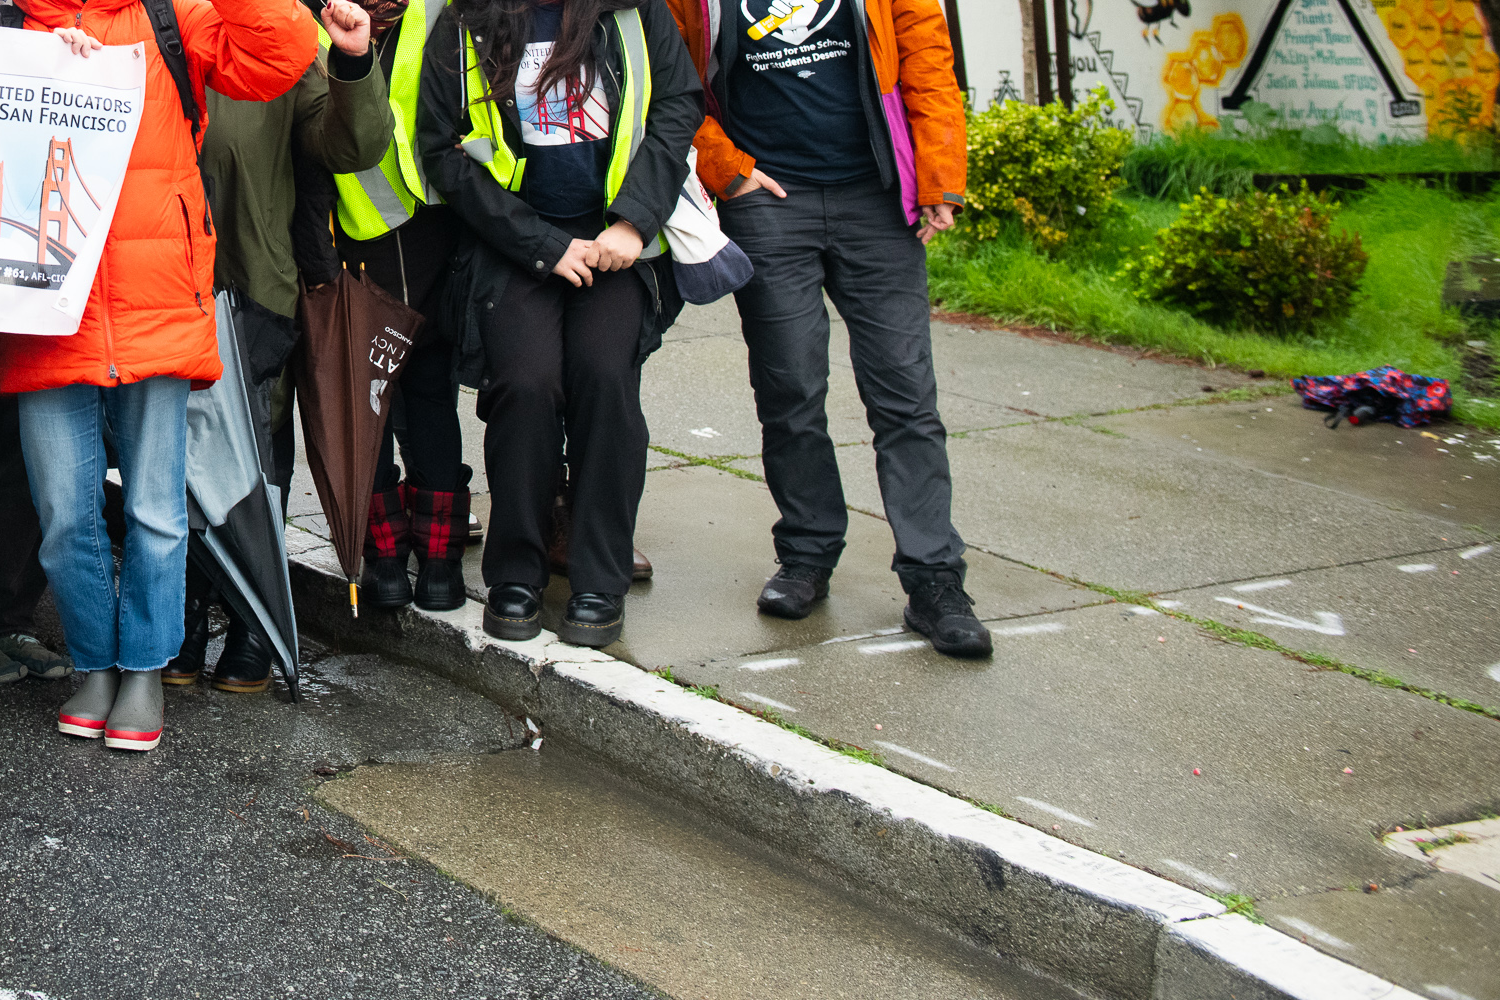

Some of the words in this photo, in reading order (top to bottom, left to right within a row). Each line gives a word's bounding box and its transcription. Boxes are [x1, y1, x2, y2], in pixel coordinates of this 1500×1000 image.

[524, 47, 551, 58] NITED
[746, 50, 782, 62] Fighting
[783, 46, 798, 56] for
[799, 43, 816, 53] the
[817, 39, 851, 50] Schools
[752, 62, 769, 72] Our
[770, 55, 811, 69] Students
[812, 49, 847, 61] Deserve
[41, 86, 132, 114] EDUCATORS
[39, 107, 127, 133] FRANCISCO
[3, 266, 28, 281] #61,
[31, 271, 67, 283] AFL-CIO
